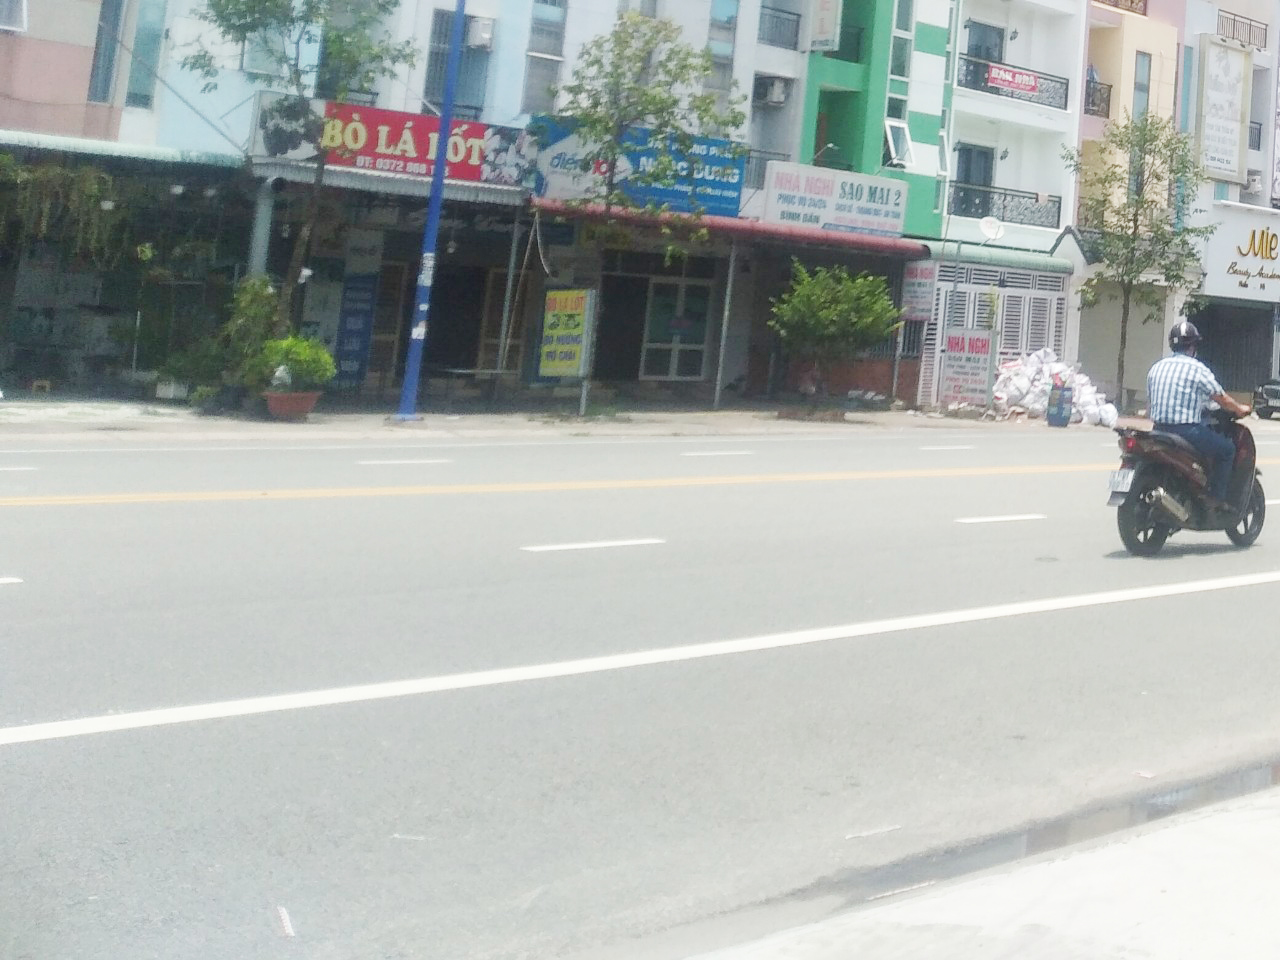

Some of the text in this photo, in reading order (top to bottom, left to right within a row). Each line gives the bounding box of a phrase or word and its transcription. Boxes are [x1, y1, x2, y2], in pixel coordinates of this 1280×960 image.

[320, 112, 368, 151] BÒ
[375, 121, 418, 158] LÁ
[838, 181, 902, 207] SAO MAI 2
[1236, 226, 1279, 261] Mie
[1227, 261, 1252, 280] Beauty
